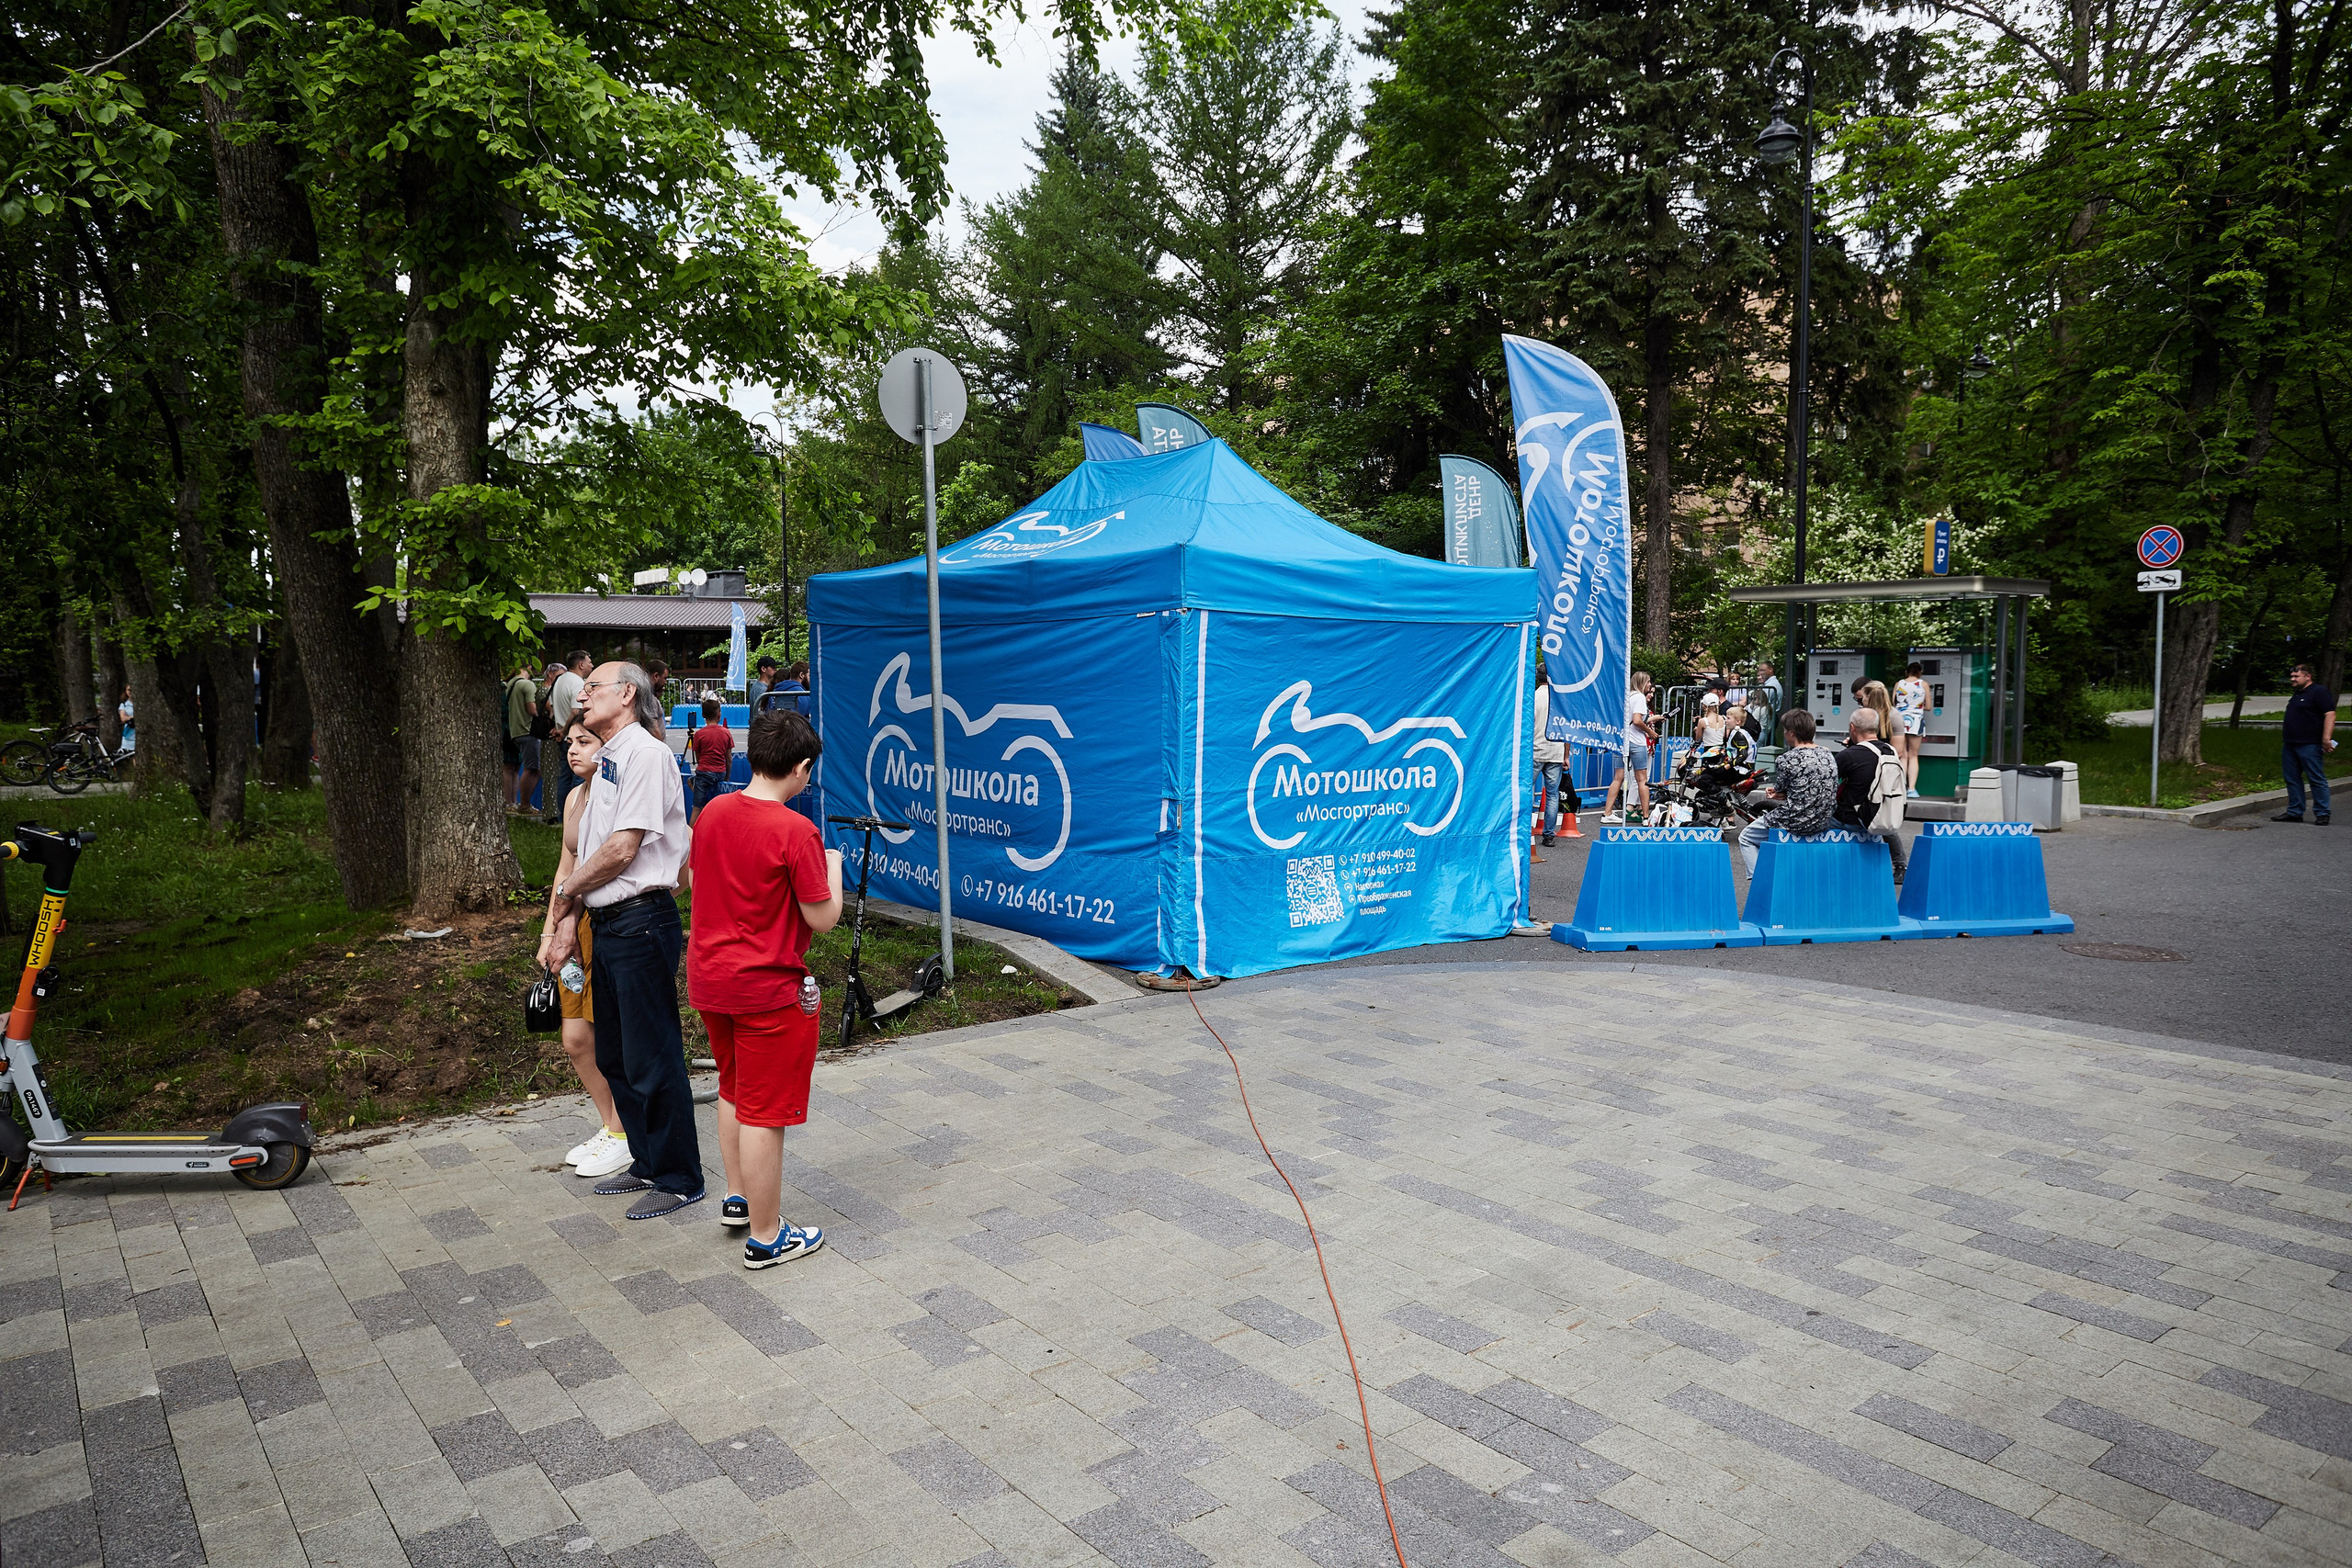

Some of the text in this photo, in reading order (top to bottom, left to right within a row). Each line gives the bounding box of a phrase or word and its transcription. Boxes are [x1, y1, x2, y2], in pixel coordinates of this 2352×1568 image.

[1272, 764, 1437, 797] Мотошкола
[904, 800, 1012, 837] «Мосортранс»
[1295, 801, 1410, 822] «Мосгортранс»
[851, 847, 865, 866] +7
[889, 857, 940, 890] 499-40-0
[1350, 848, 1416, 864] +7 910 499-40-02
[1351, 862, 1417, 878] +7 916 461-17-22
[1354, 881, 1385, 891] Нагорная
[976, 879, 1115, 924] +7 916 461-17-22
[28, 899, 54, 965] WHOOSH
[26, 1091, 40, 1115] PA1467
